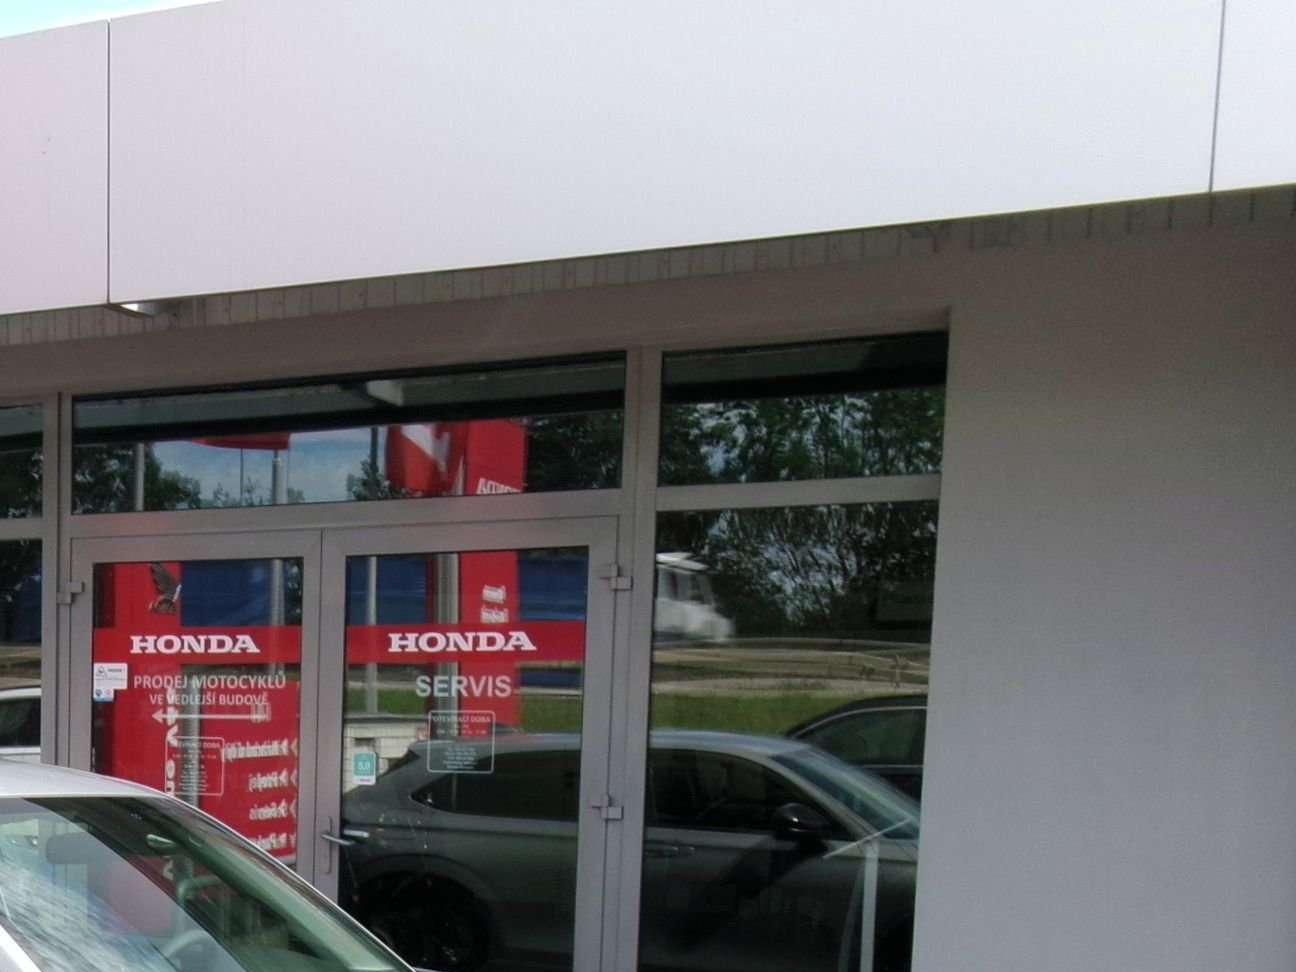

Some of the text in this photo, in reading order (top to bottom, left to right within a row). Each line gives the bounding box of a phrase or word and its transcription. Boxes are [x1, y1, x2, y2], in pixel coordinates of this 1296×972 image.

[130, 635, 261, 654] HONDA
[388, 631, 537, 653] HONDA
[133, 674, 188, 689] PRODEJ
[192, 670, 286, 689] MOTOCYKLŮ
[415, 675, 512, 698] SERVIS
[149, 691, 269, 706] VE VEDLEJŠÍ BUDOVĚ
